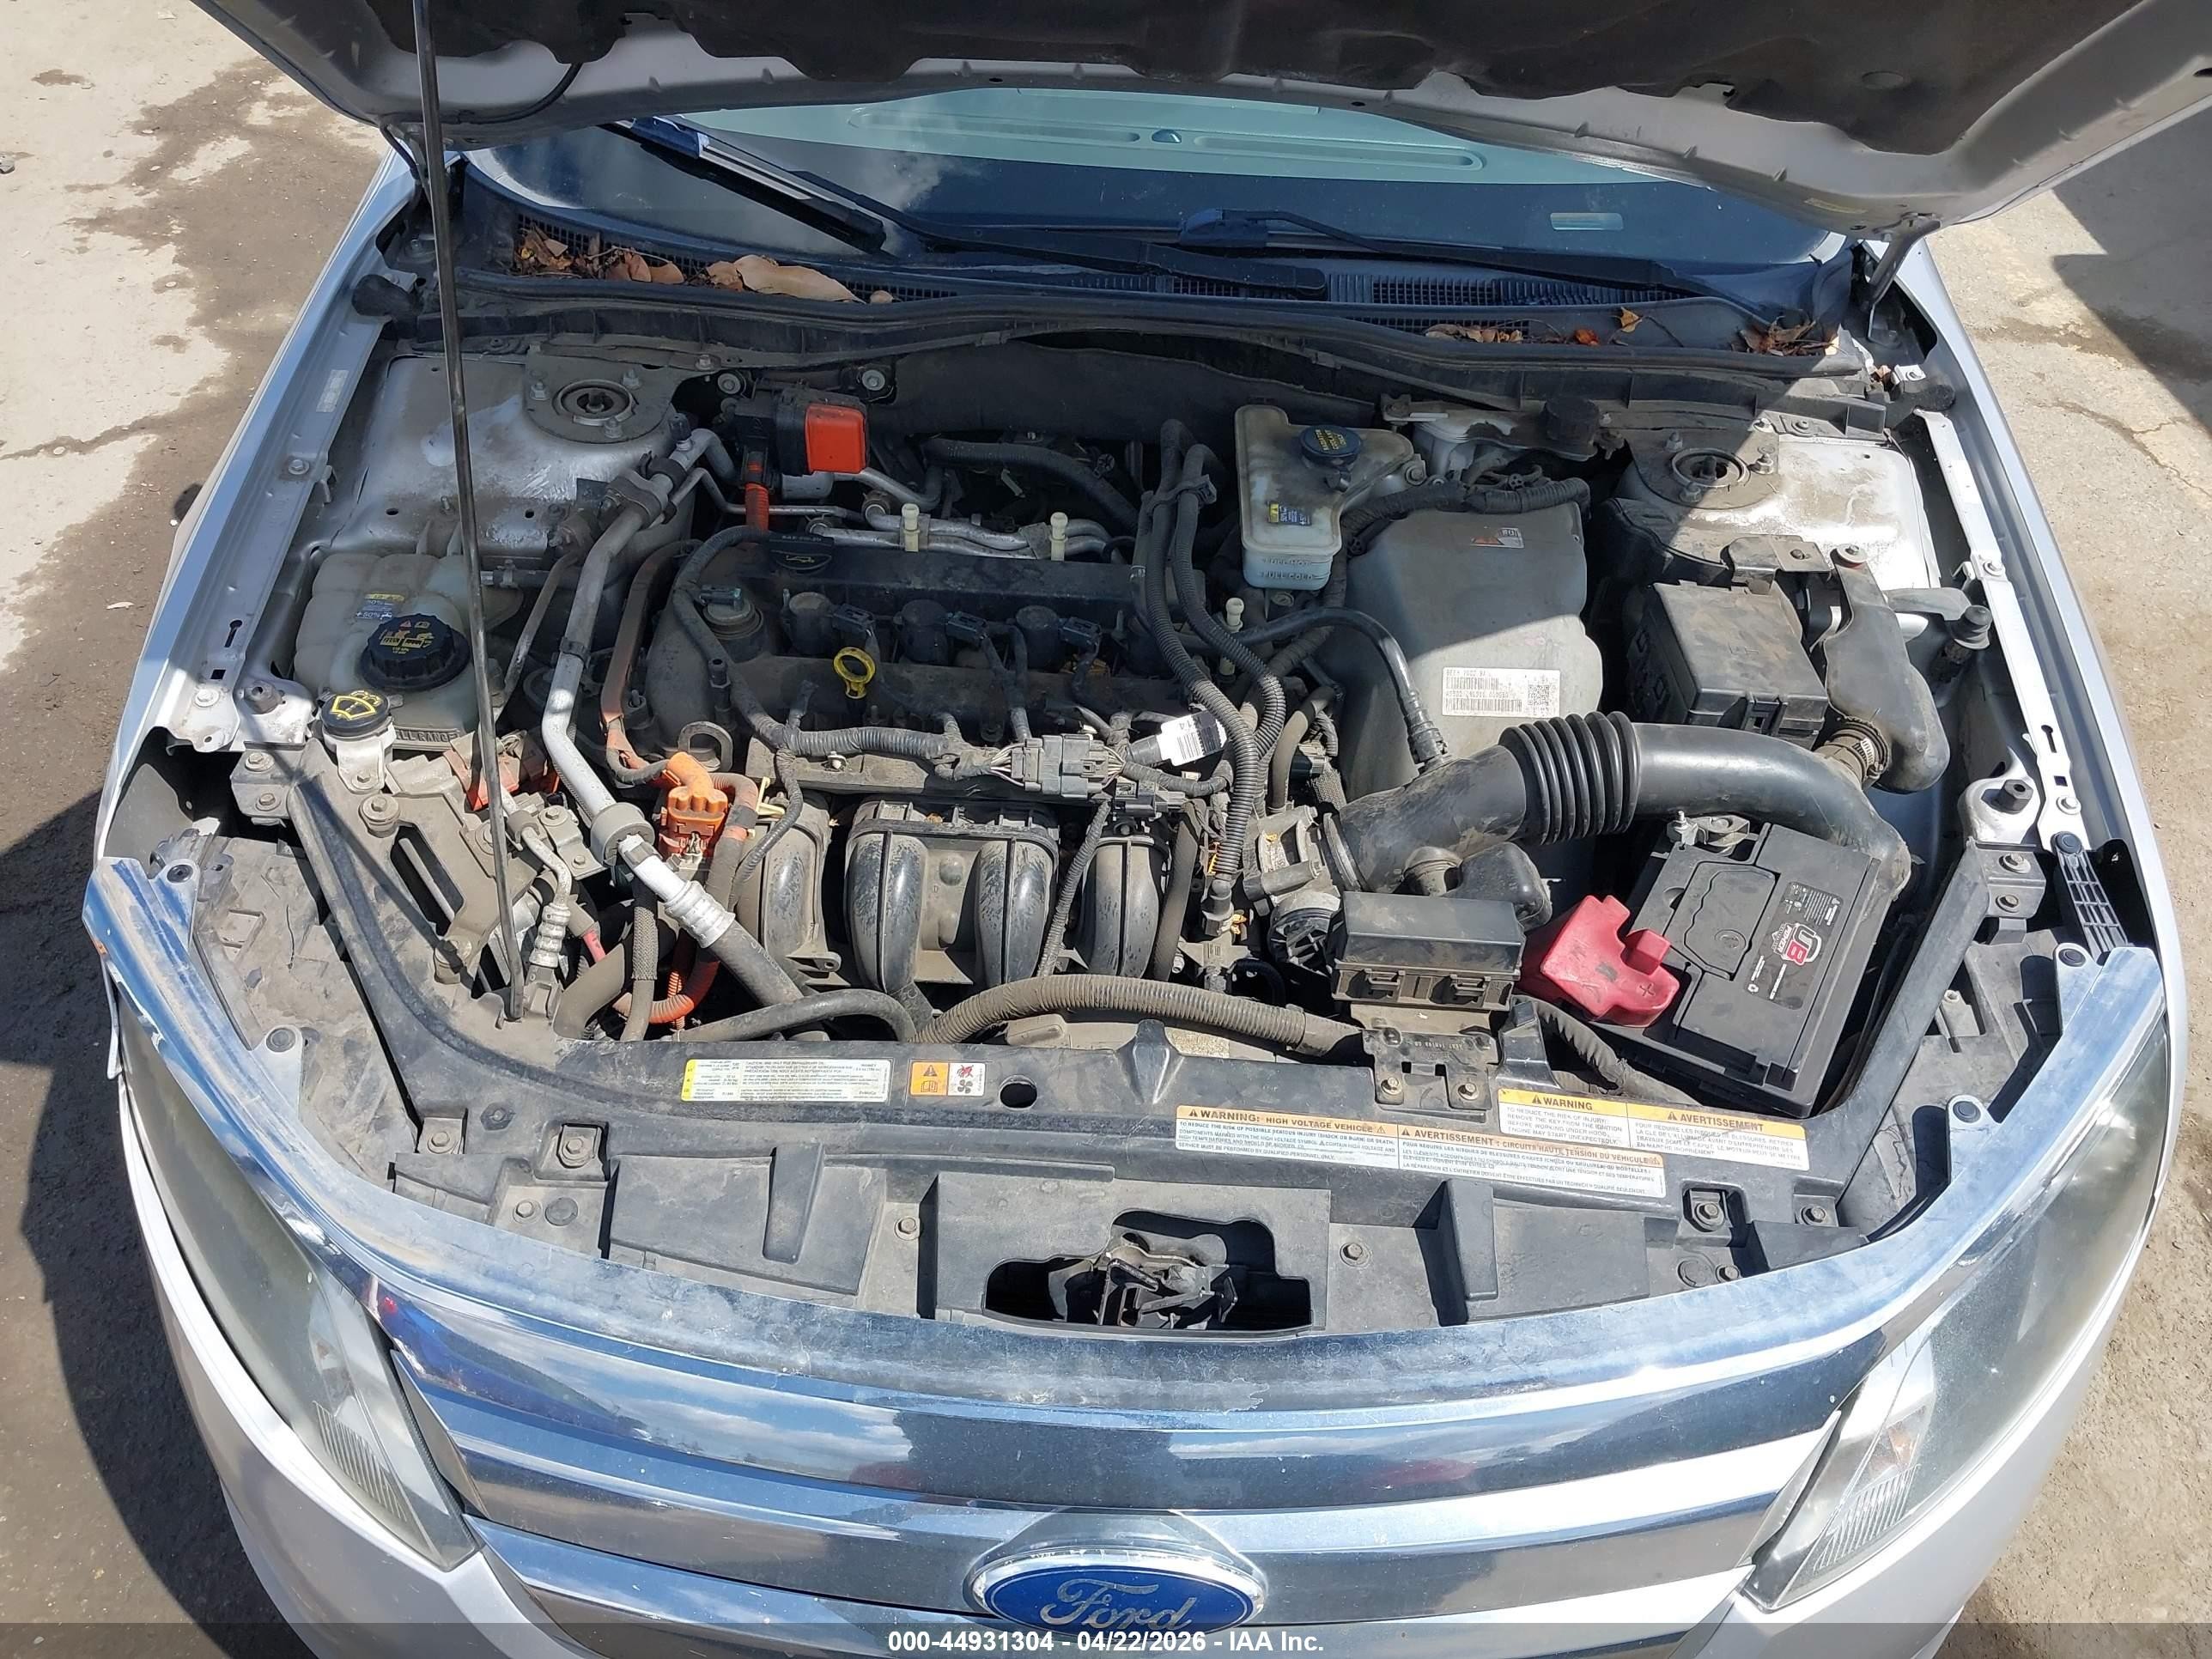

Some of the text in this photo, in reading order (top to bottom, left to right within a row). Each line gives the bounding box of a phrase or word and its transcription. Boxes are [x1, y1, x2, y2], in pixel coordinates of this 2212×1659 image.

[1543, 1097, 1592, 1110] WARNING
[1200, 1109, 1260, 1122] WARNING:
[1291, 1119, 1331, 1128] VOLTAGE
[1334, 1122, 1372, 1132] VEHICLE
[1680, 1113, 1763, 1132] AVERTISSEMENT
[1414, 1129, 1493, 1146] AVERTISSEMENT
[1539, 1145, 1561, 1154] HAUTE
[1565, 1148, 1596, 1158] TENSION
[1040, 1578, 1197, 1631] Ford
